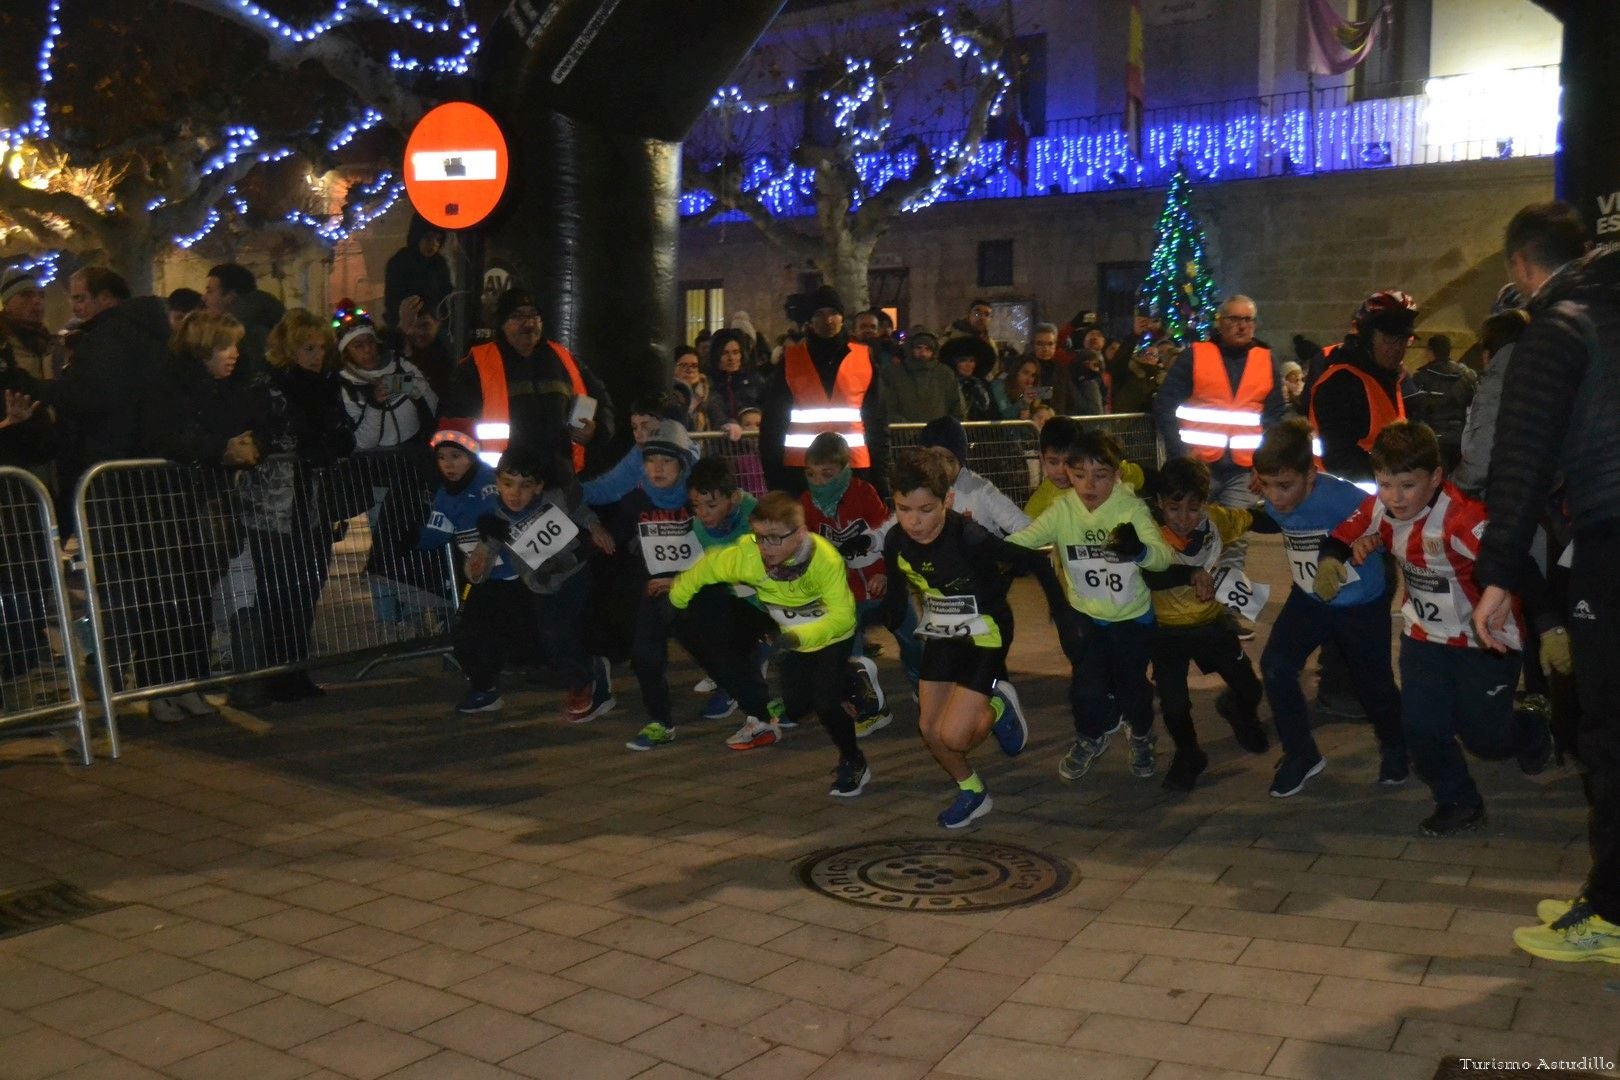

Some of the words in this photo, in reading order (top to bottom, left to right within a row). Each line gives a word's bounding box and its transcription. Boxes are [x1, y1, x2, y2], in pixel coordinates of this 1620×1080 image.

[526, 520, 562, 554] 706
[655, 544, 692, 561] 839
[1085, 570, 1123, 592] 678
